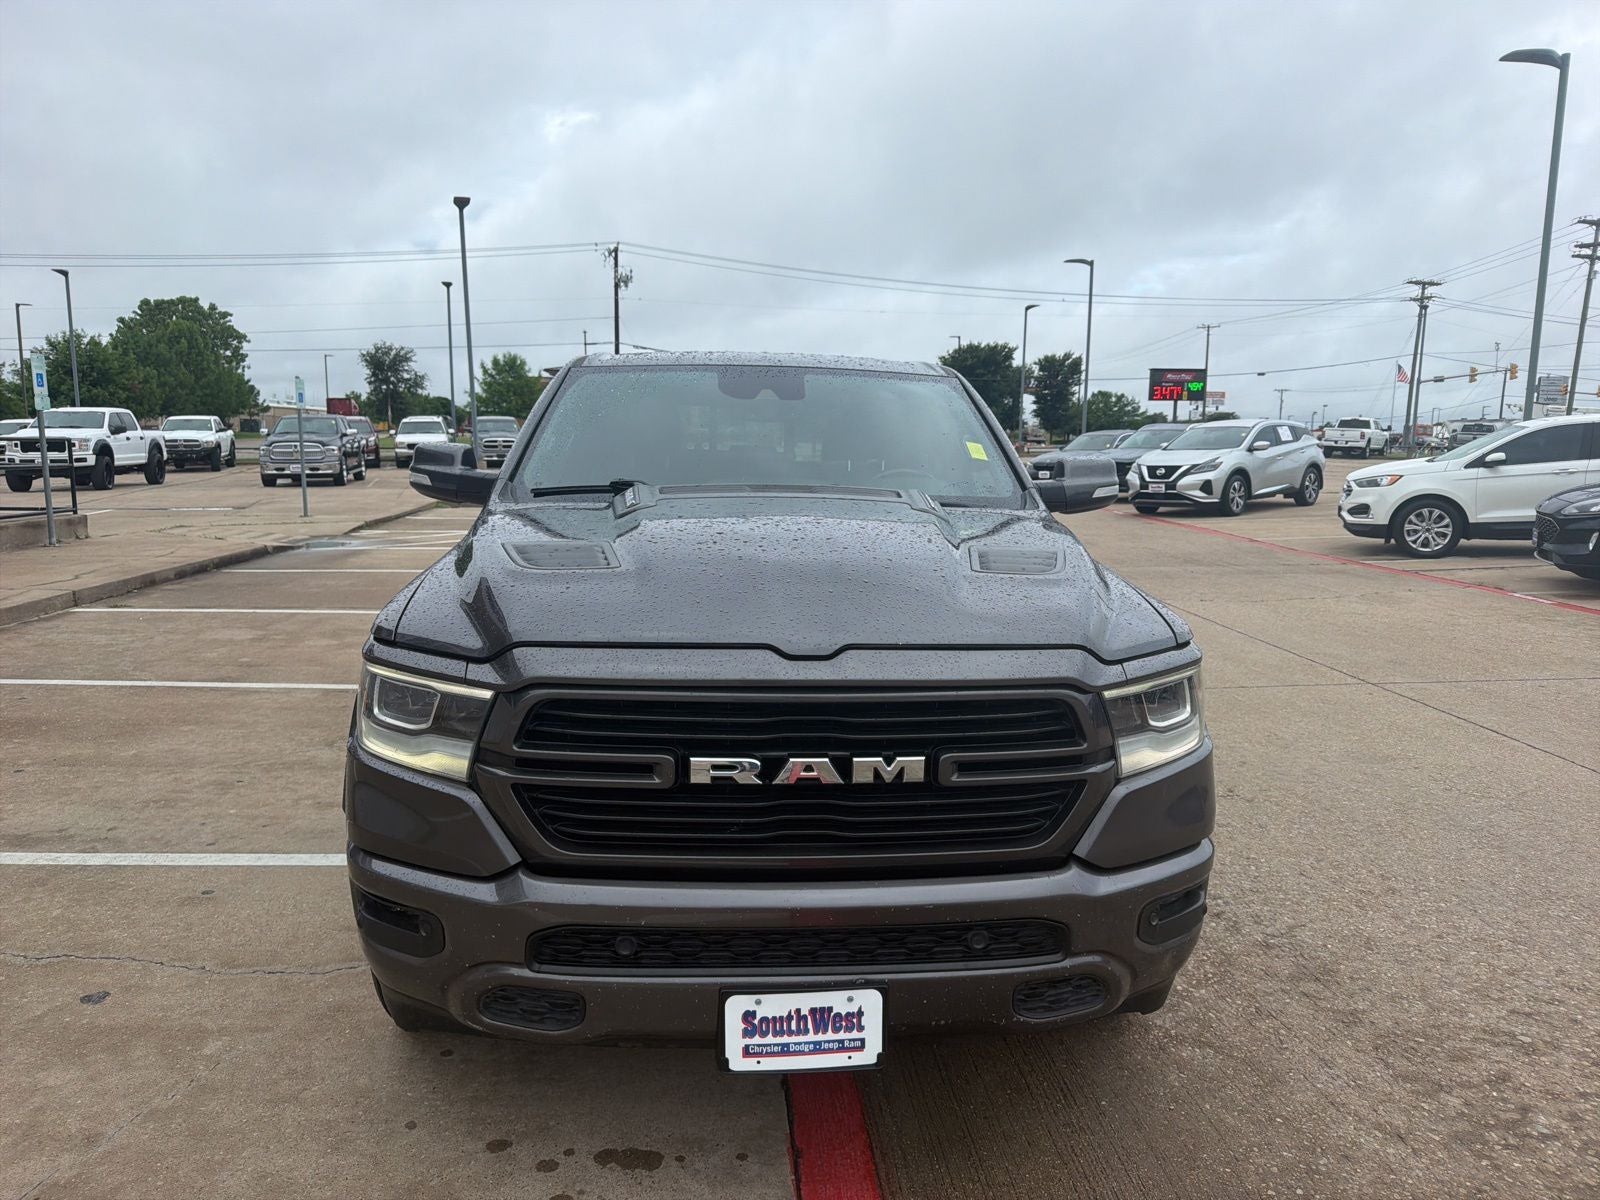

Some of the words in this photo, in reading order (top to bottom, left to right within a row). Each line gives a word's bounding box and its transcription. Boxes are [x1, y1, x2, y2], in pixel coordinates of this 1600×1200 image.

[689, 757, 926, 785] RAM
[741, 1005, 865, 1039] SouthWest
[749, 1044, 782, 1054] Chrysler
[789, 1042, 814, 1052] Dodge
[820, 1040, 839, 1050] Jeep
[844, 1039, 861, 1048] Ram
